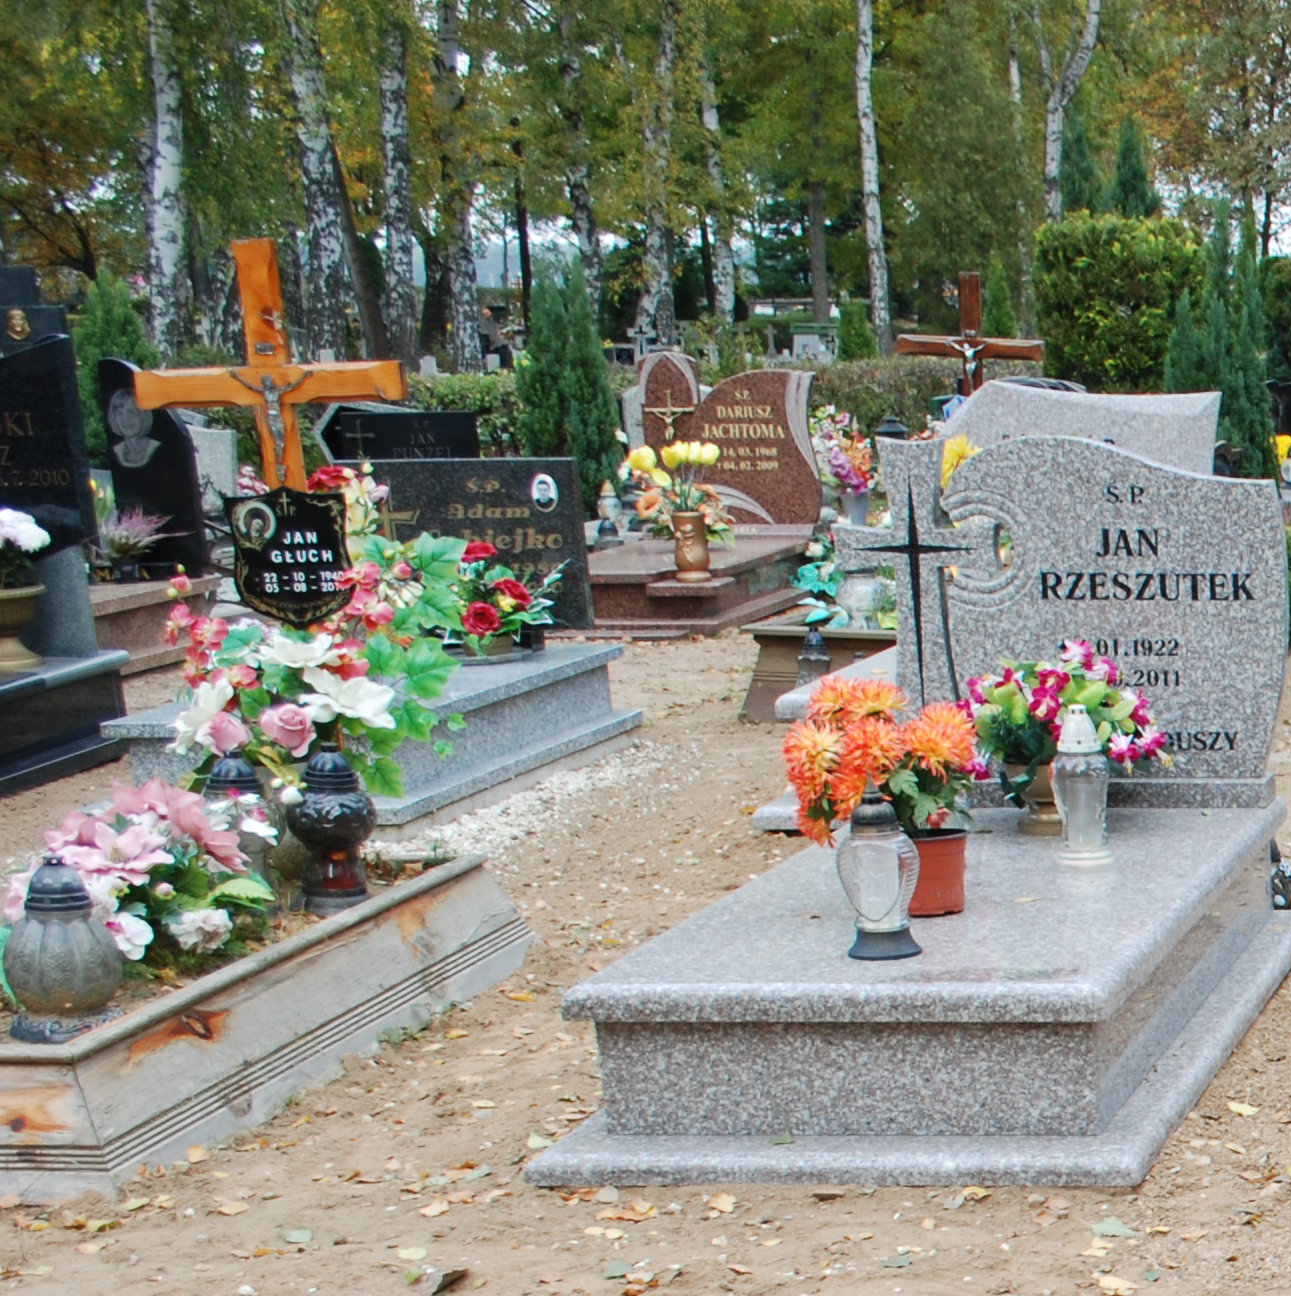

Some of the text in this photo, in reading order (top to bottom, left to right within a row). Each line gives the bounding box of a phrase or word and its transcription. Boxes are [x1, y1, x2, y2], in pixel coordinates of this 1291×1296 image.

[717, 405, 773, 419] DARIUSZ
[0, 412, 35, 436] KI
[702, 423, 785, 439] JACHTOMA
[447, 503, 531, 519] Adam
[283, 531, 318, 544] JAN
[1095, 528, 1159, 558] JAN
[271, 549, 333, 564] GŁUCH
[264, 572, 278, 583] 22
[293, 572, 305, 582] 10
[1040, 571, 1256, 602] RZESZUTEK
